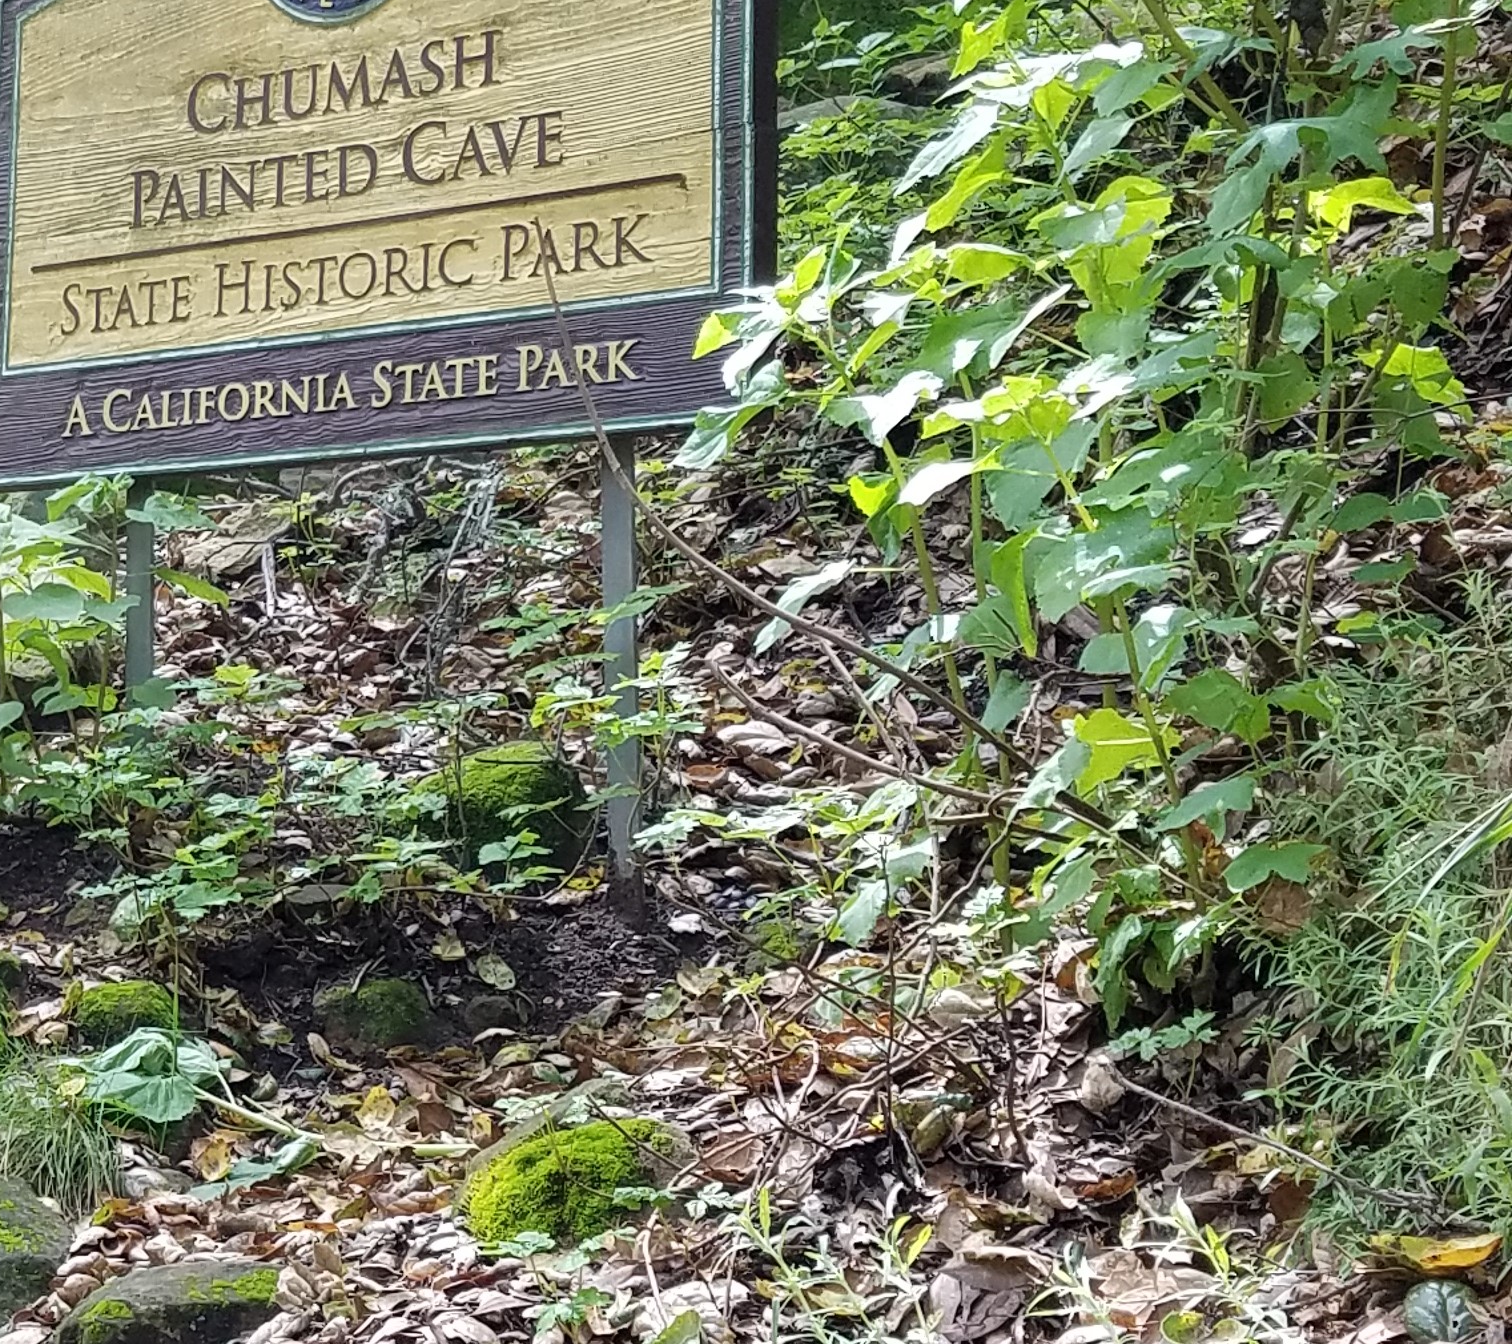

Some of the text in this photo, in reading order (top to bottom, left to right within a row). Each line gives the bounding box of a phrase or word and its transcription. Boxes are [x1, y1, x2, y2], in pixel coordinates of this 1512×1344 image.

[187, 30, 503, 134] CHUMASH
[129, 111, 564, 229] PAINTED CAVE
[60, 213, 652, 336] STATE HISTORIC PARK
[62, 340, 640, 439] A CALIFORNIA STATE PARK
